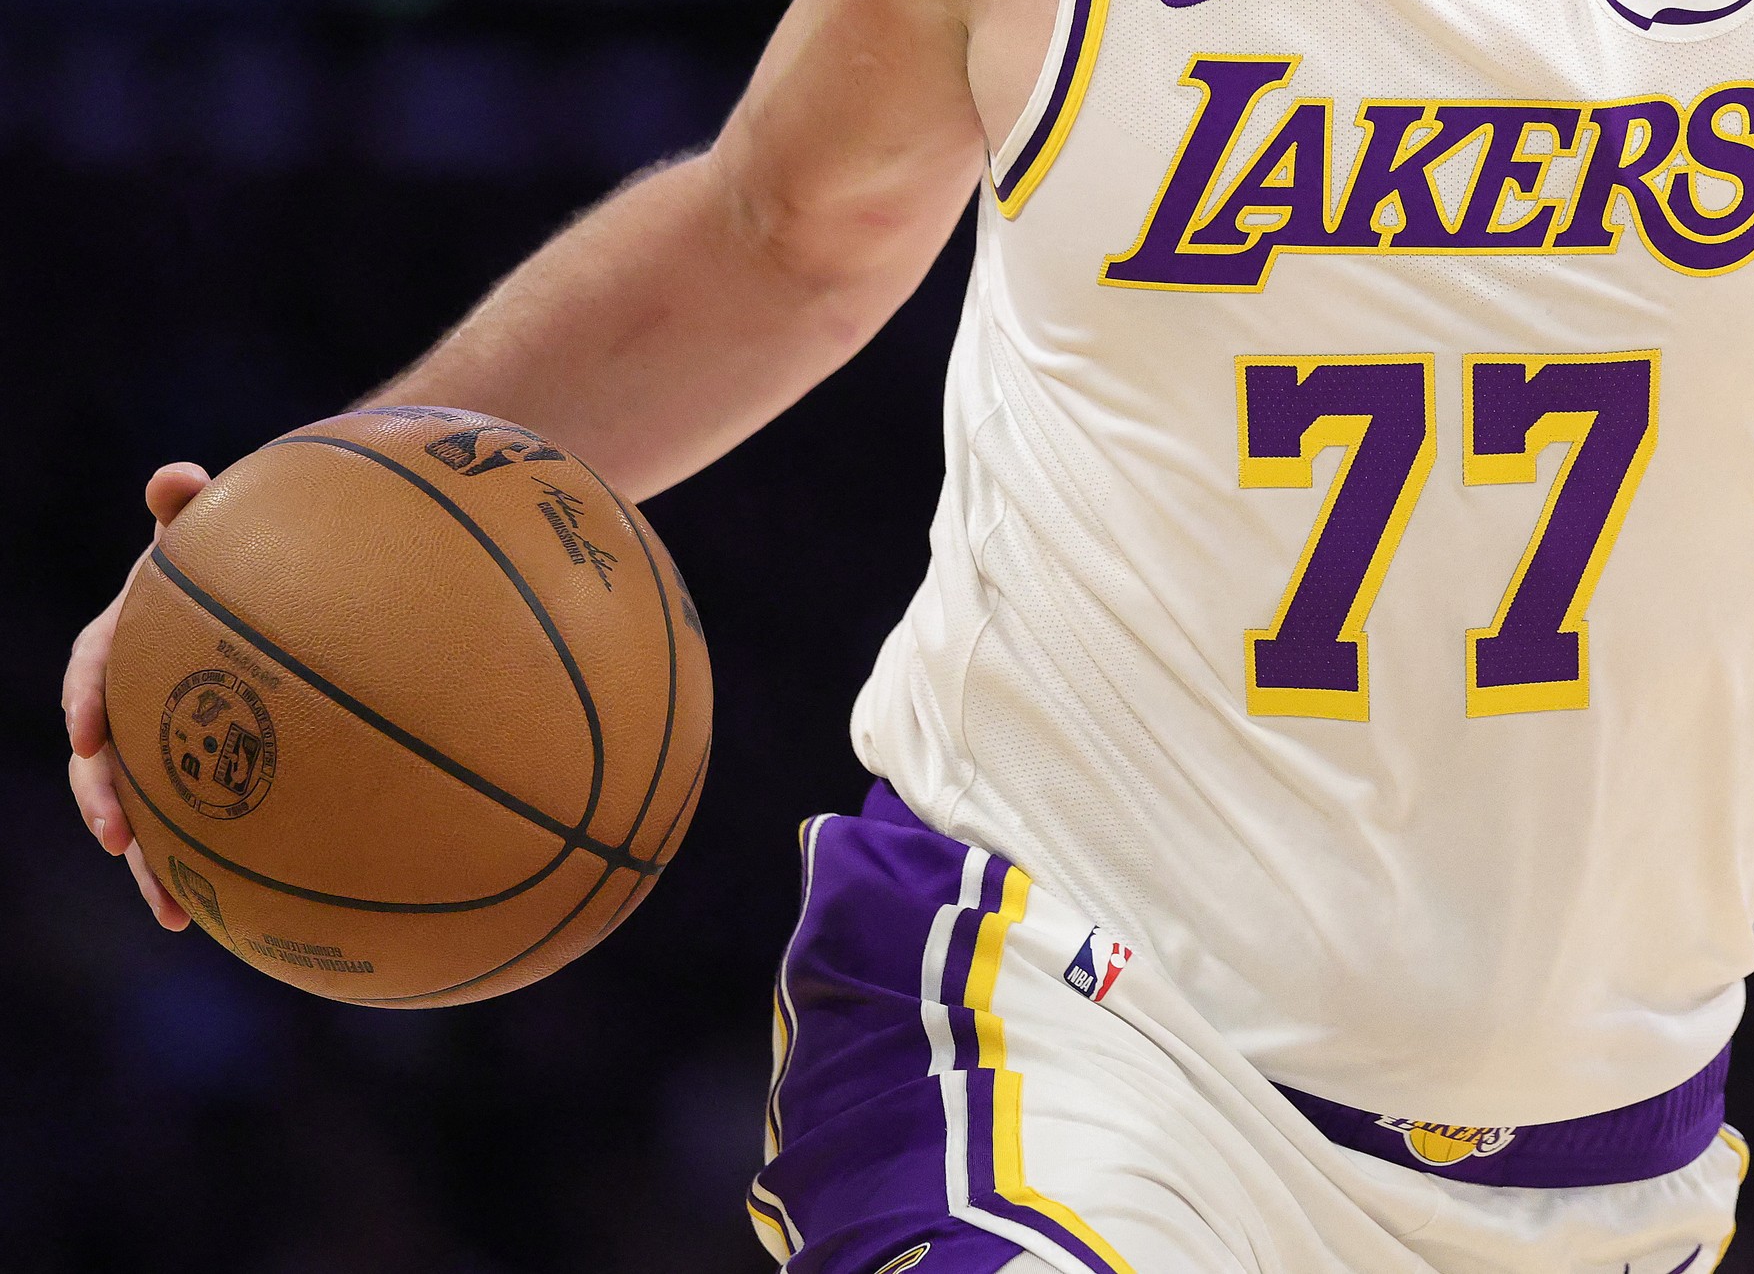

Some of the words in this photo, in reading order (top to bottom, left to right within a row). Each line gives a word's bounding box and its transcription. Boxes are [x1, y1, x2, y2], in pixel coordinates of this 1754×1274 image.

[537, 501, 586, 565] COMMISSIONER
[1234, 348, 1662, 722] 77
[313, 957, 374, 973] OFFICIAL
[1067, 965, 1094, 993] NBA
